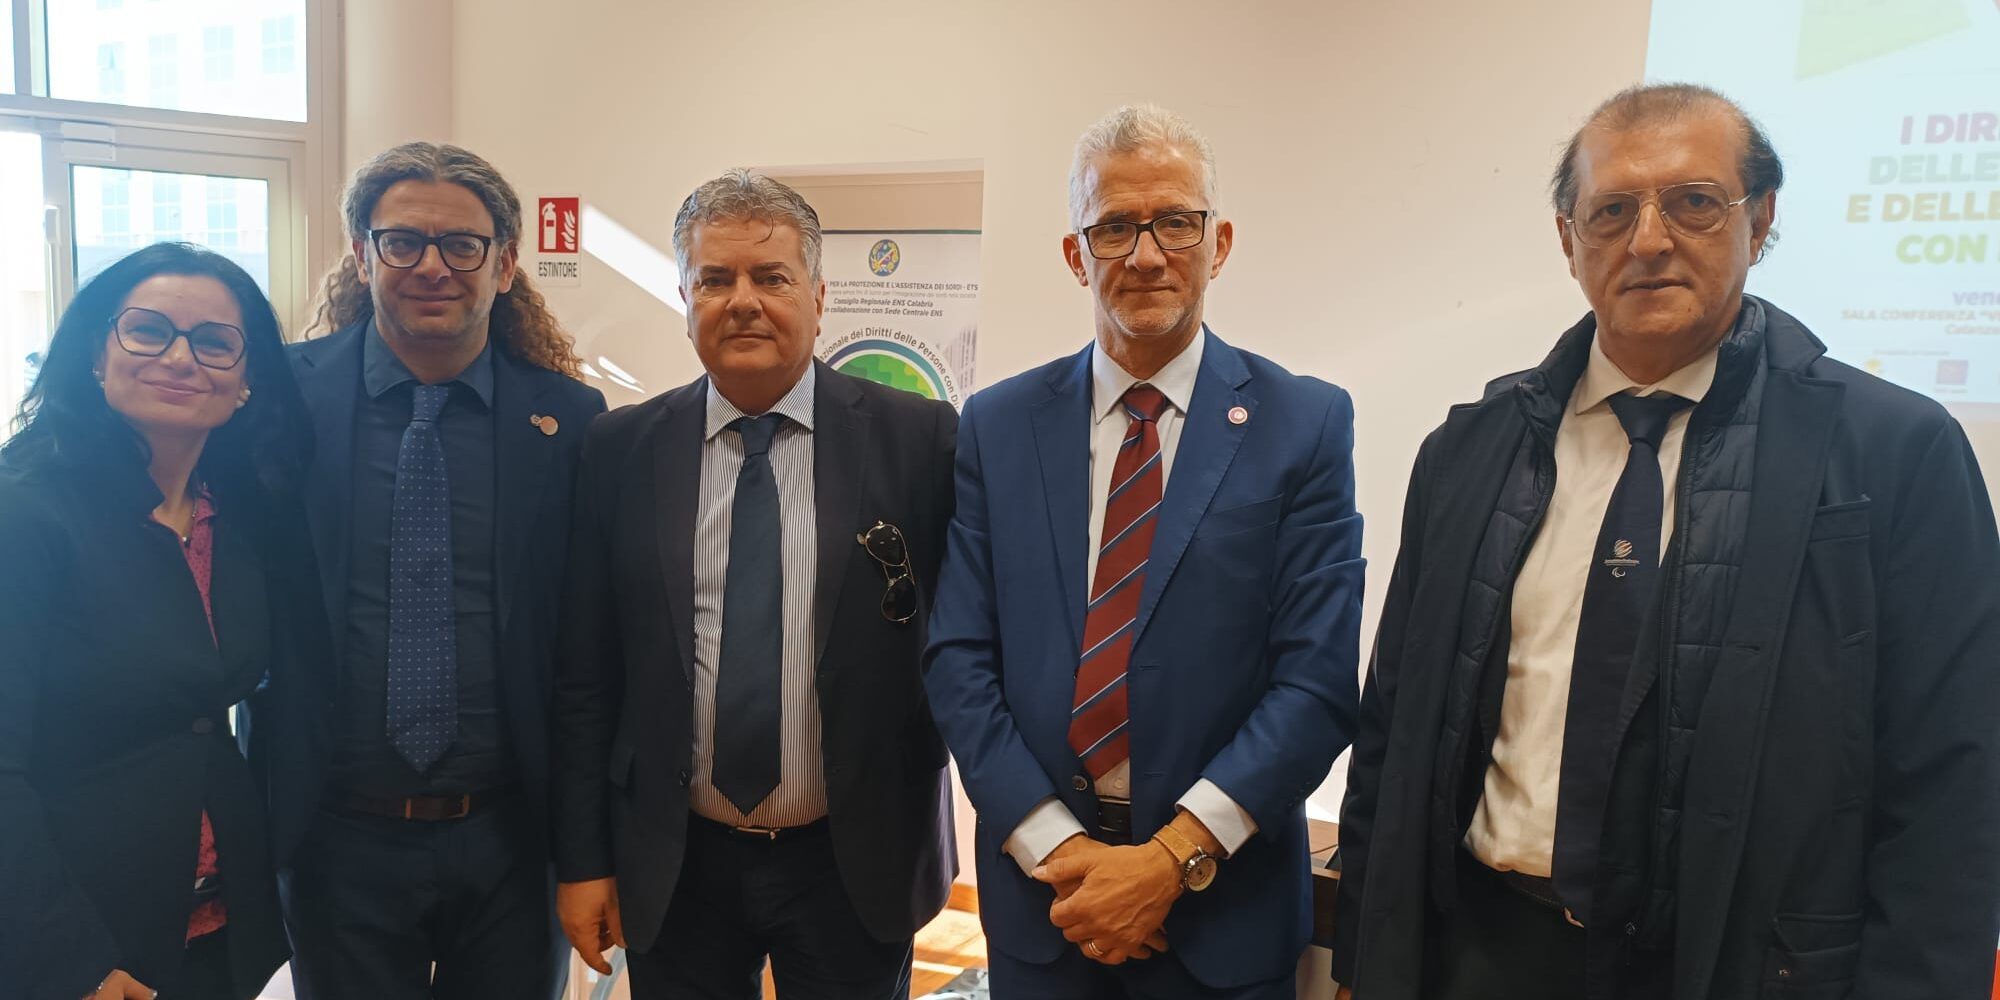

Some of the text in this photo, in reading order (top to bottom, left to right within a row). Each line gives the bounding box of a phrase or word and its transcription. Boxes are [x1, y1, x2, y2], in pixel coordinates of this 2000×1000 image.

[1900, 112, 2000, 145] I DIR
[1869, 152, 2000, 185] DELLE
[1846, 194, 1872, 223] E
[1895, 233, 1988, 265] CON
[538, 262, 577, 278] ESTINTORE
[848, 281, 885, 289] PROTEZIONE
[891, 282, 933, 291] L'ASSISTENZA
[945, 283, 962, 291] SORDI
[833, 297, 934, 308] Consiglio Regionale ENS Calabria
[884, 307, 901, 315] Sede
[902, 308, 930, 317] Centrale
[930, 309, 943, 317] ENS
[1841, 310, 1877, 320] SALA
[1880, 309, 1976, 321] CONFERENZA
[851, 330, 864, 340] dei
[865, 327, 893, 338] Diritti
[894, 330, 917, 347] delle
[918, 342, 946, 375] Persone
[944, 375, 954, 394] con
